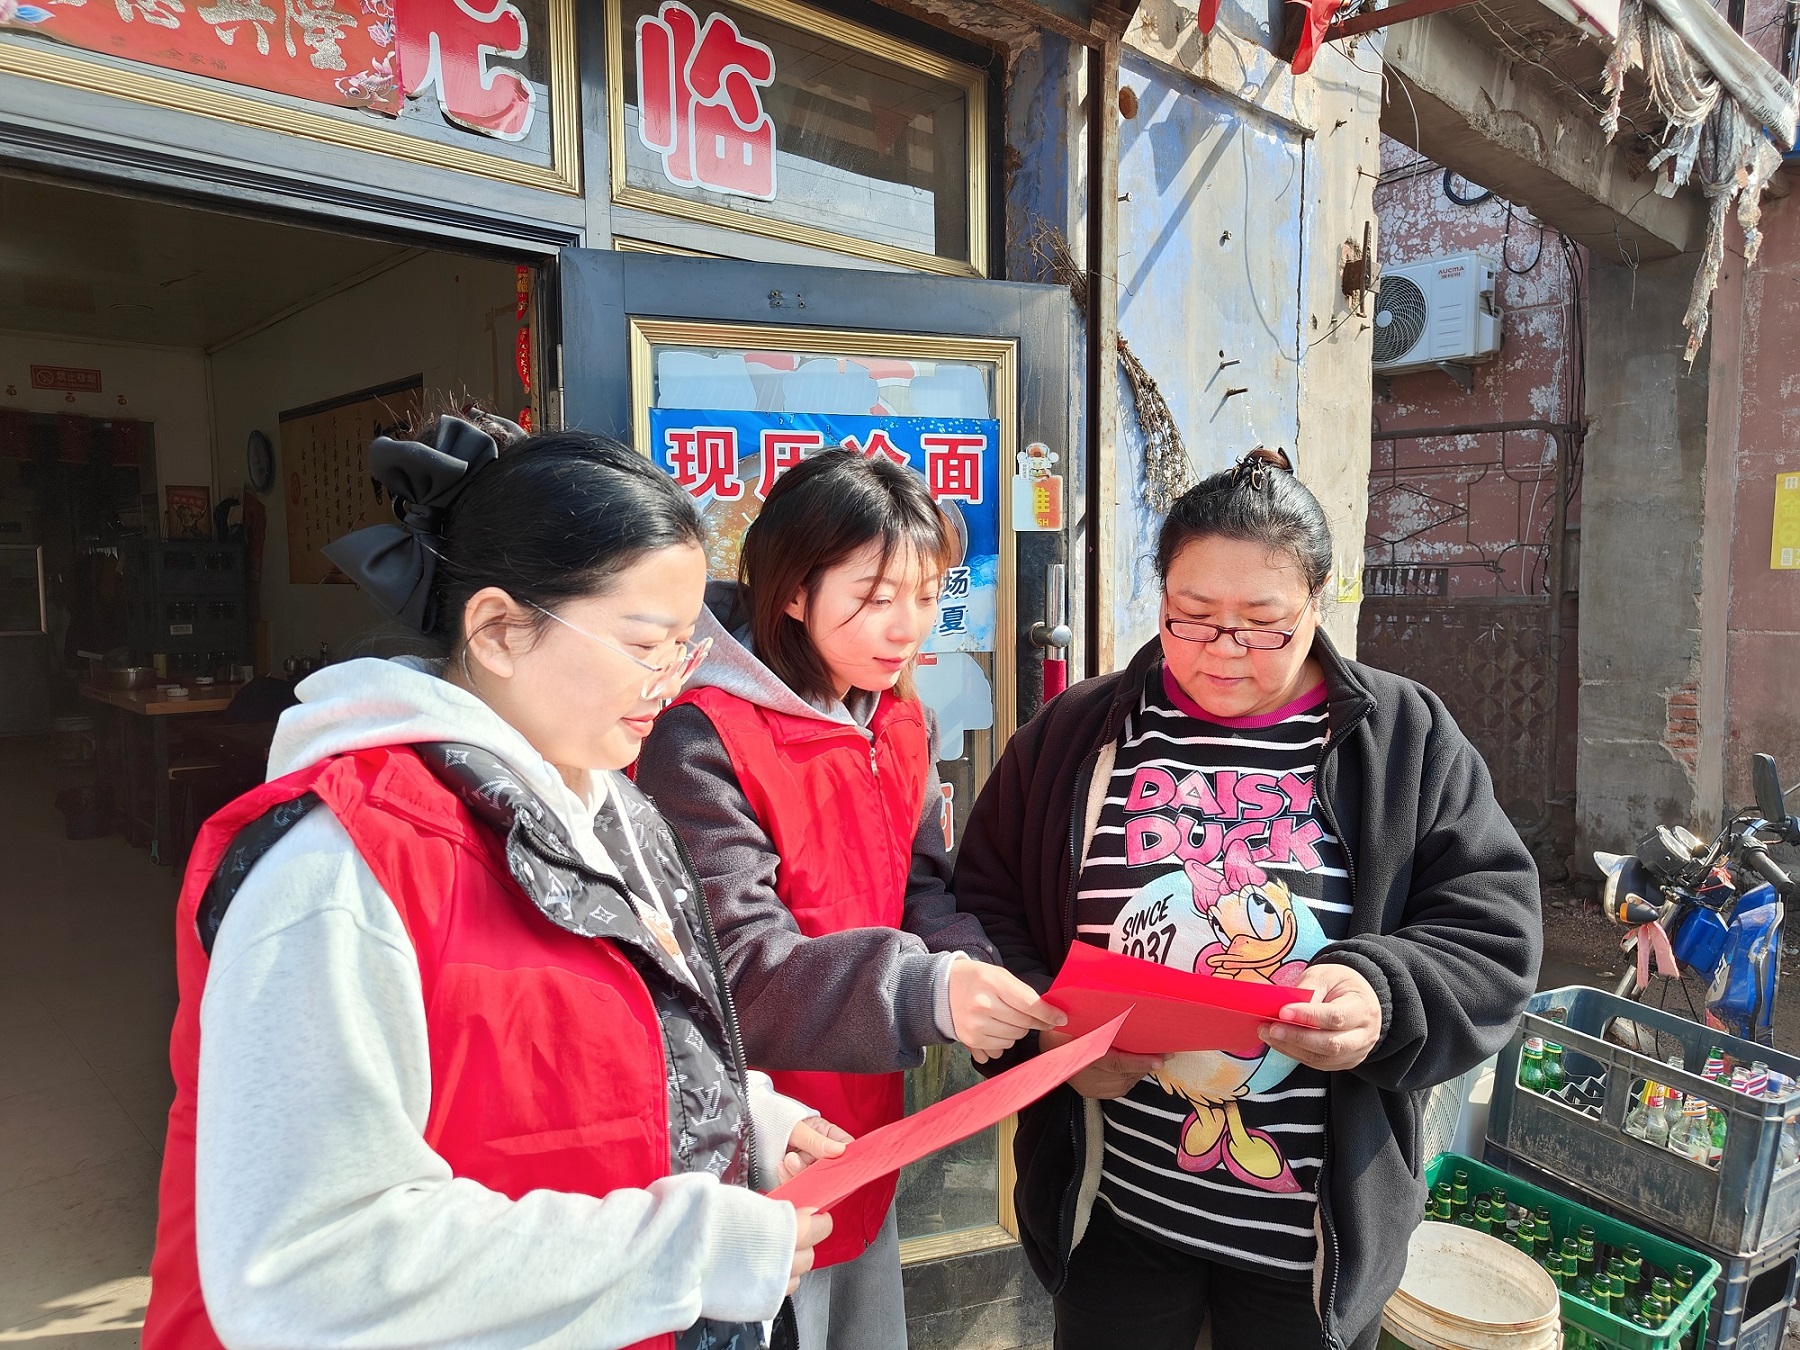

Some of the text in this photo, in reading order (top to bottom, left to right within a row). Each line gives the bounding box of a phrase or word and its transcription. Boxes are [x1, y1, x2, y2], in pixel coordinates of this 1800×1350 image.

[636, 0, 777, 201] 临
[1437, 266, 1465, 275] AUCMA
[1036, 518, 1049, 526] SH
[1124, 766, 1316, 820] DAISY
[1125, 815, 1325, 872] DUCK
[1121, 893, 1174, 941] SINCE
